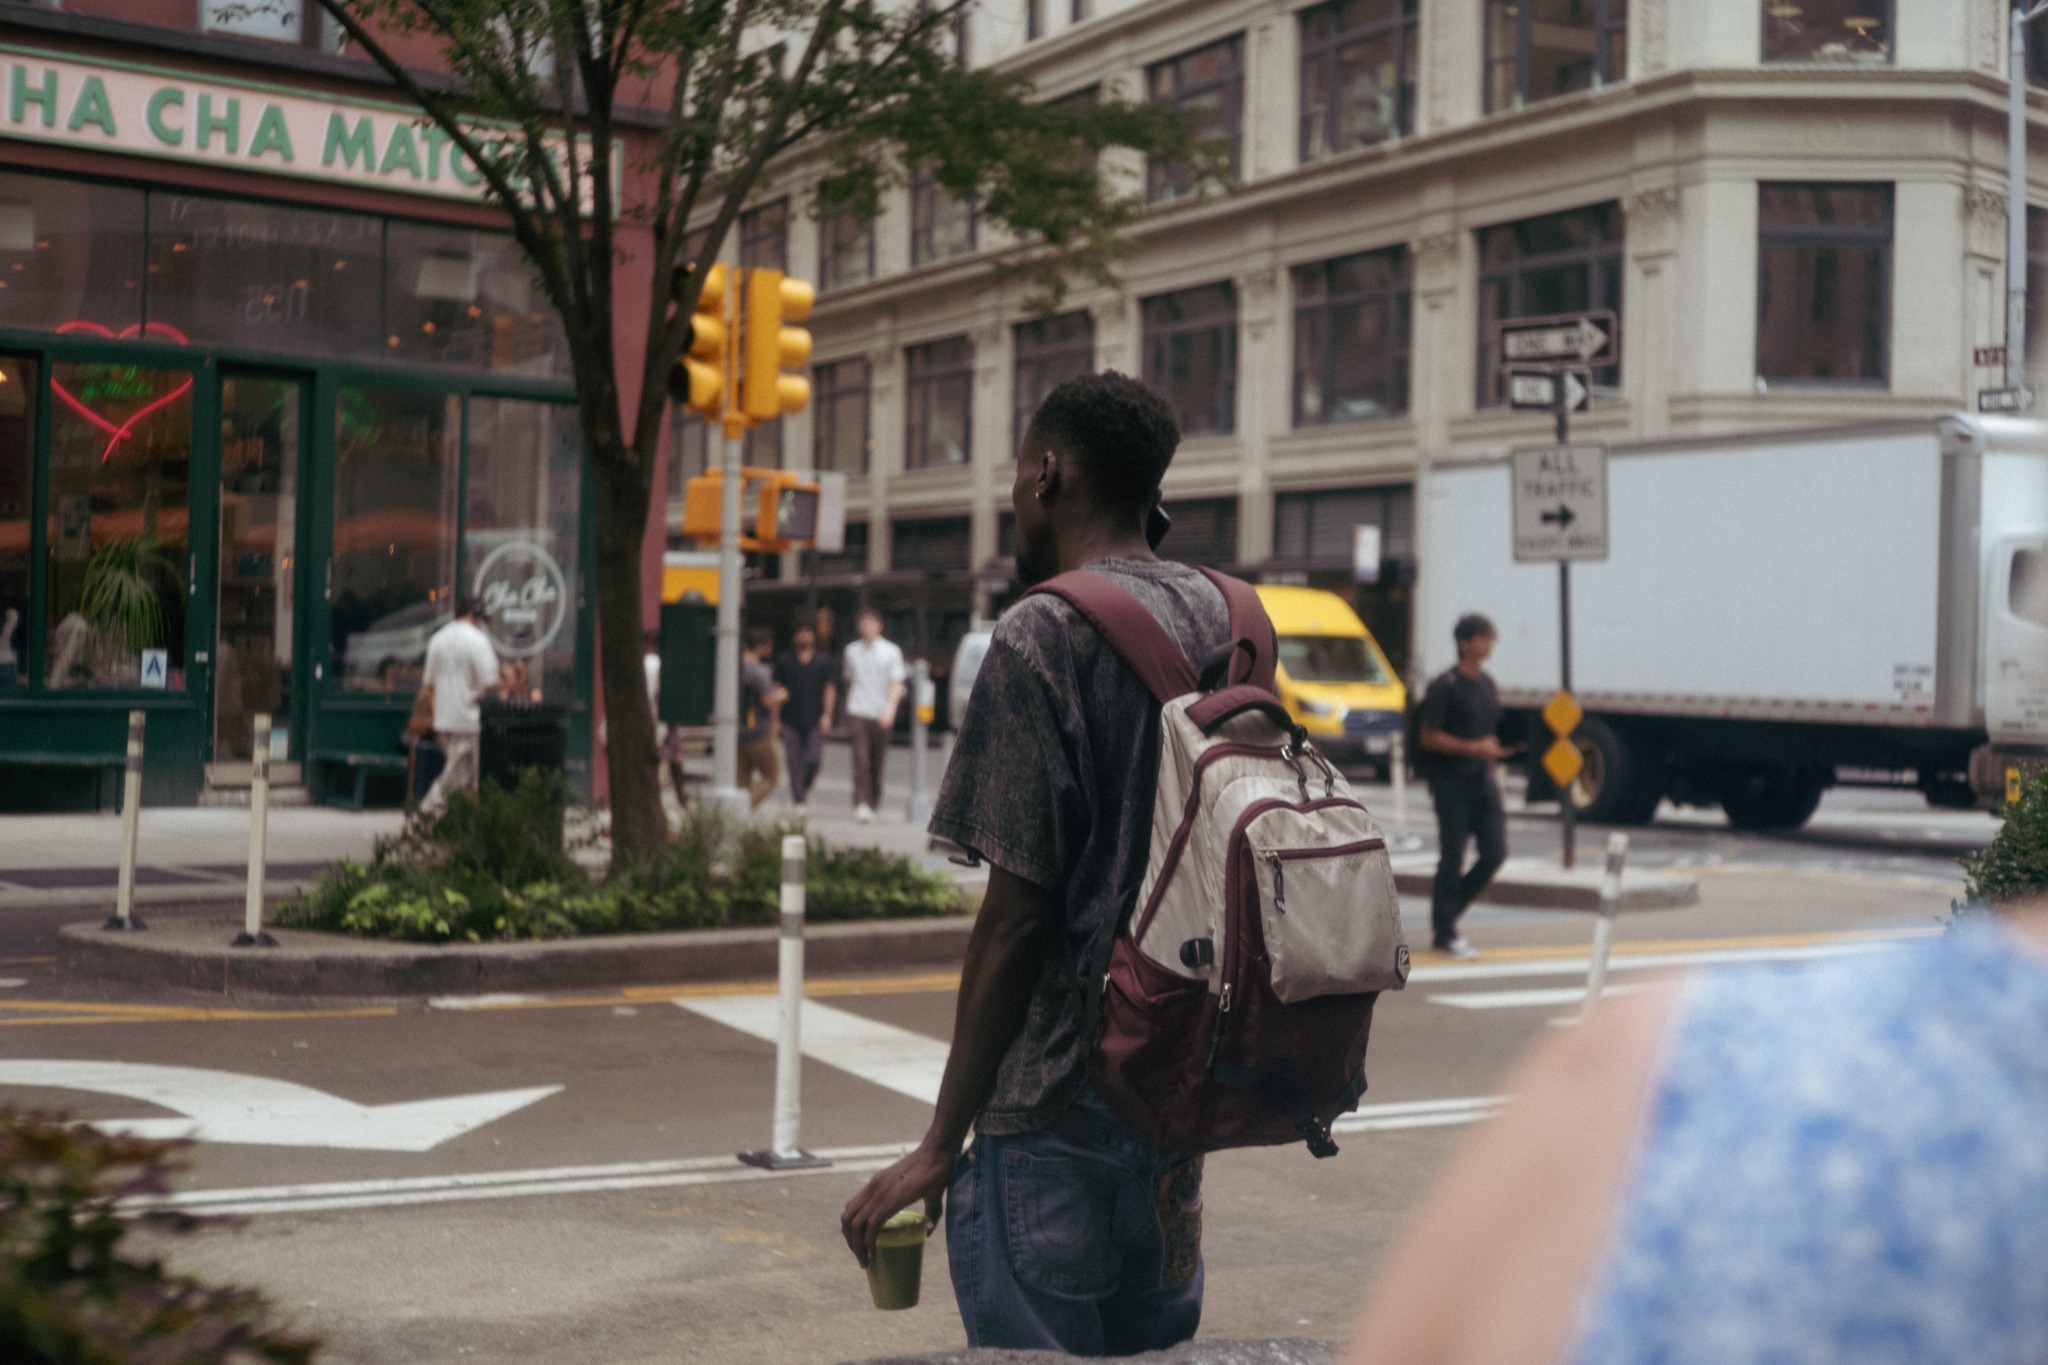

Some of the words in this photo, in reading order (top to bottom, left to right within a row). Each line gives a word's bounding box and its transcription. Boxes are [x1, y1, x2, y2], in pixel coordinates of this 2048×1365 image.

[146, 87, 294, 161] CHA
[1539, 452, 1579, 474] ALL
[1522, 479, 1595, 500] TRAFFIC
[146, 655, 161, 677] A
